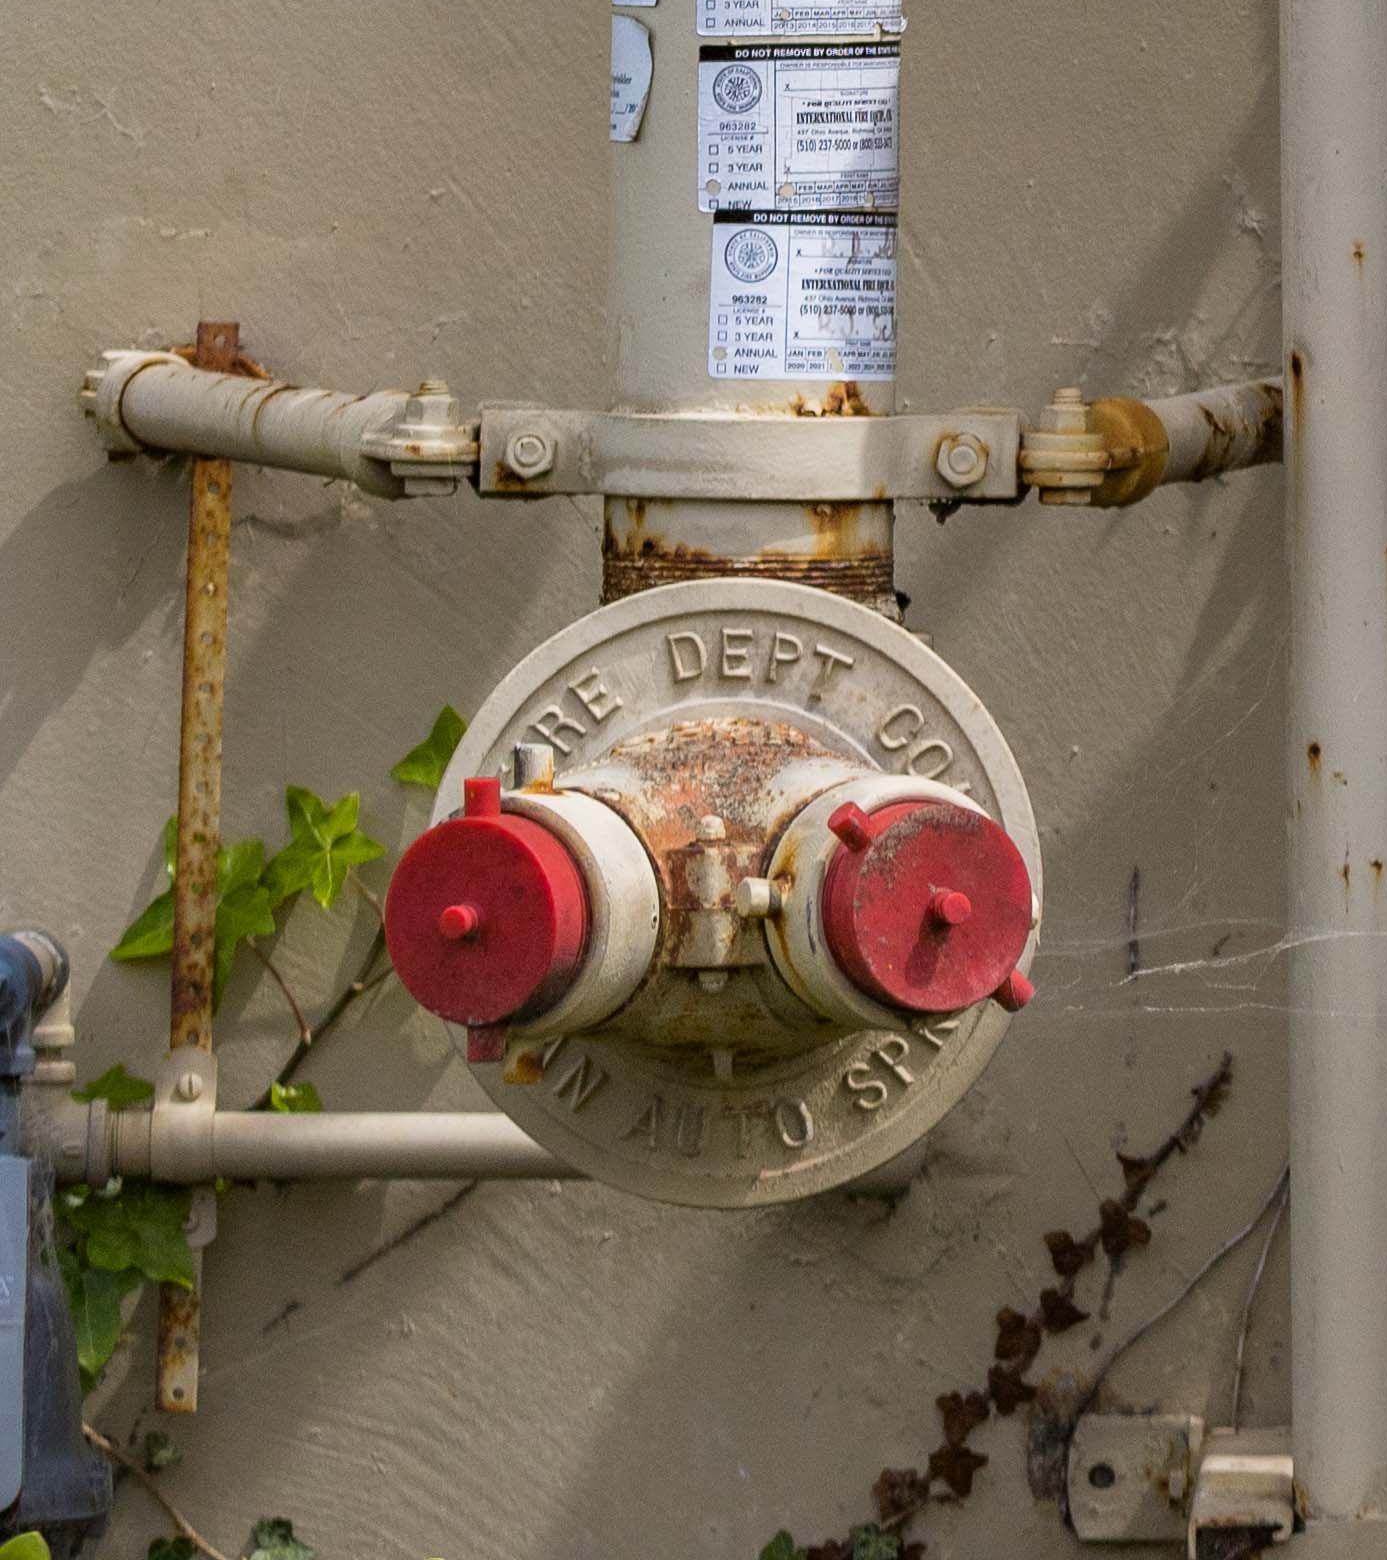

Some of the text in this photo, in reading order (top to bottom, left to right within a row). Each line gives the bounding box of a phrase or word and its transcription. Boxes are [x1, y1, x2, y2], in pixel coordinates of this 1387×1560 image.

[754, 213, 839, 224] DO NOT REMOVE BY
[801, 279, 861, 291] INTERNATIONAL
[732, 295, 768, 305] 963282
[800, 305, 822, 316] (510)
[734, 349, 777, 358] ANNUAL
[734, 364, 760, 374] NEW
[665, 627, 856, 698] DEPT
[623, 1094, 814, 1158] AUTO
